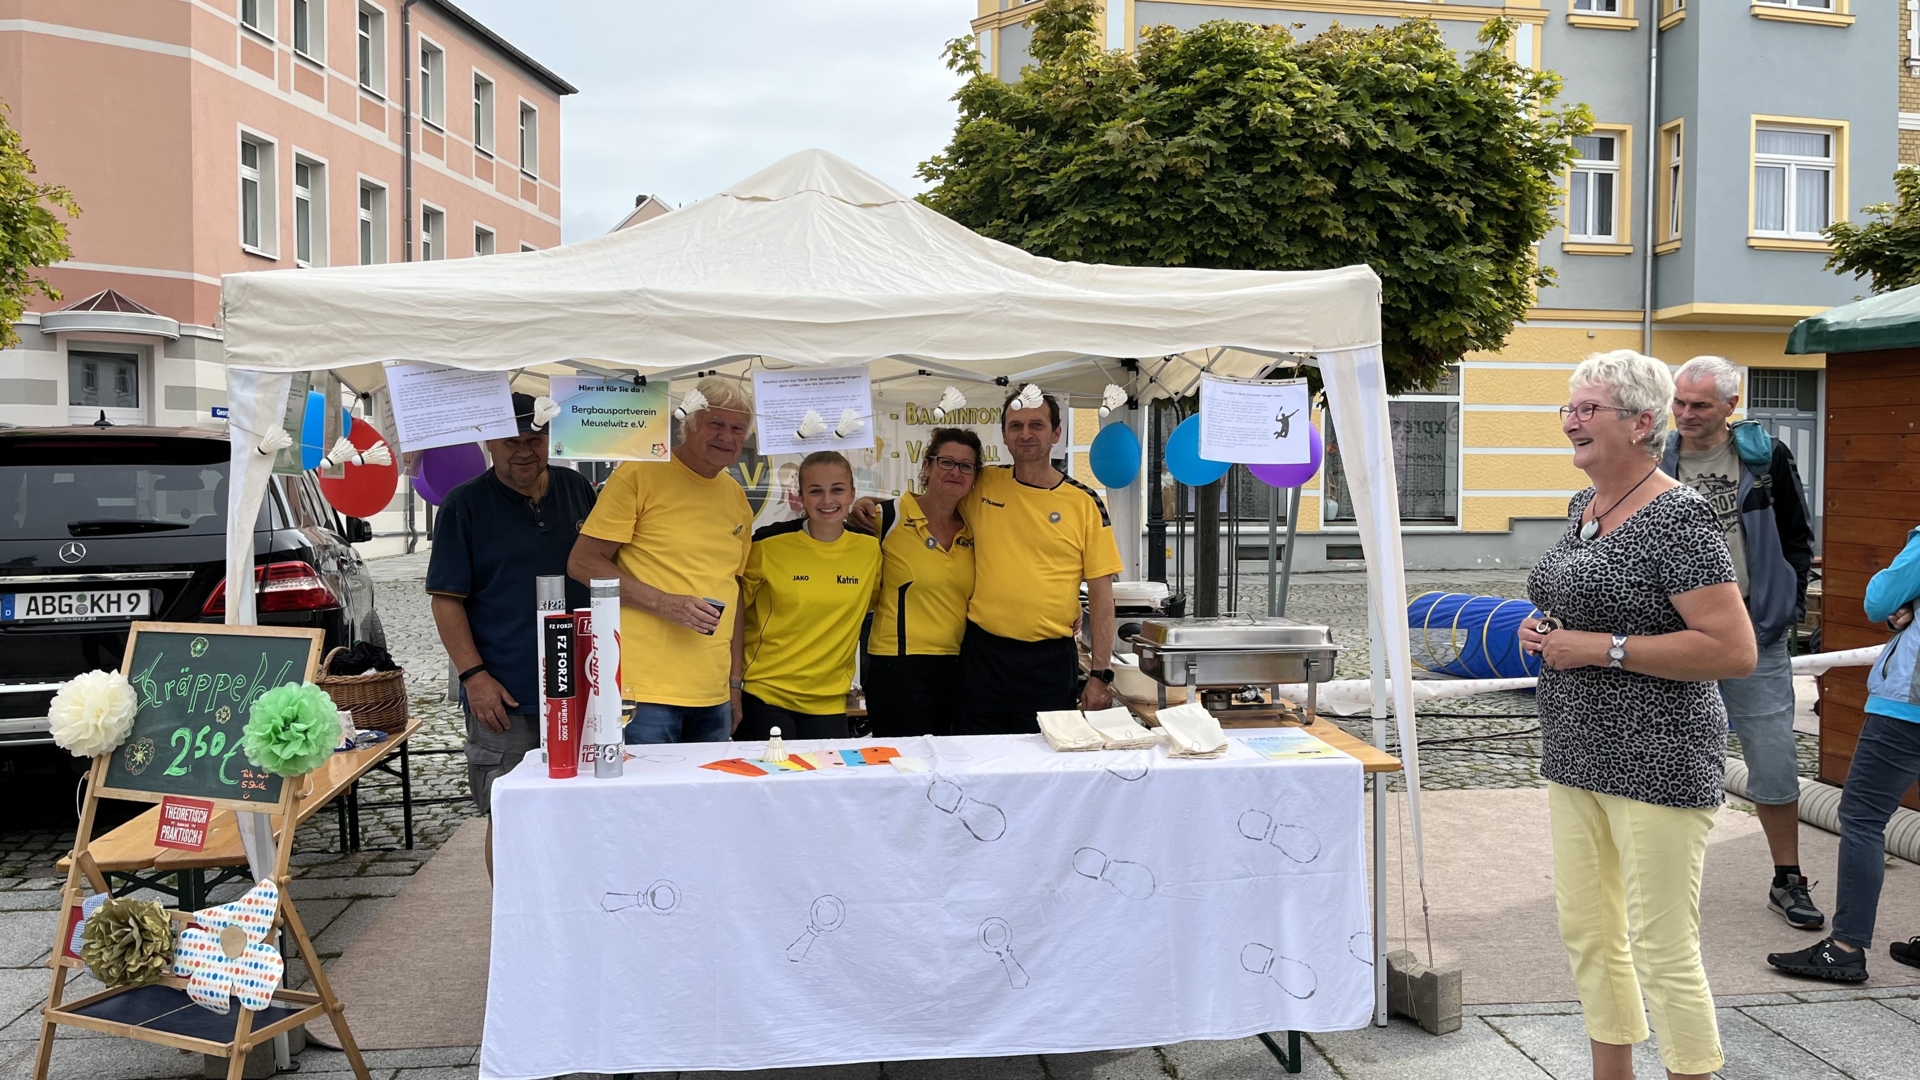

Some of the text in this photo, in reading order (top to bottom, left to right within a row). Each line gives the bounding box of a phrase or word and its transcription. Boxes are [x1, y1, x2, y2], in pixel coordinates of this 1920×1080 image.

[571, 405, 656, 416] Bergbausportverein
[581, 418, 629, 428] Meuselwitz
[836, 575, 858, 584] Katrin
[26, 593, 141, 616] ABG KH 9
[557, 635, 567, 692] FZ FORZA
[165, 805, 208, 824] THEORETISCH
[160, 825, 198, 844] PRAKTISCH
